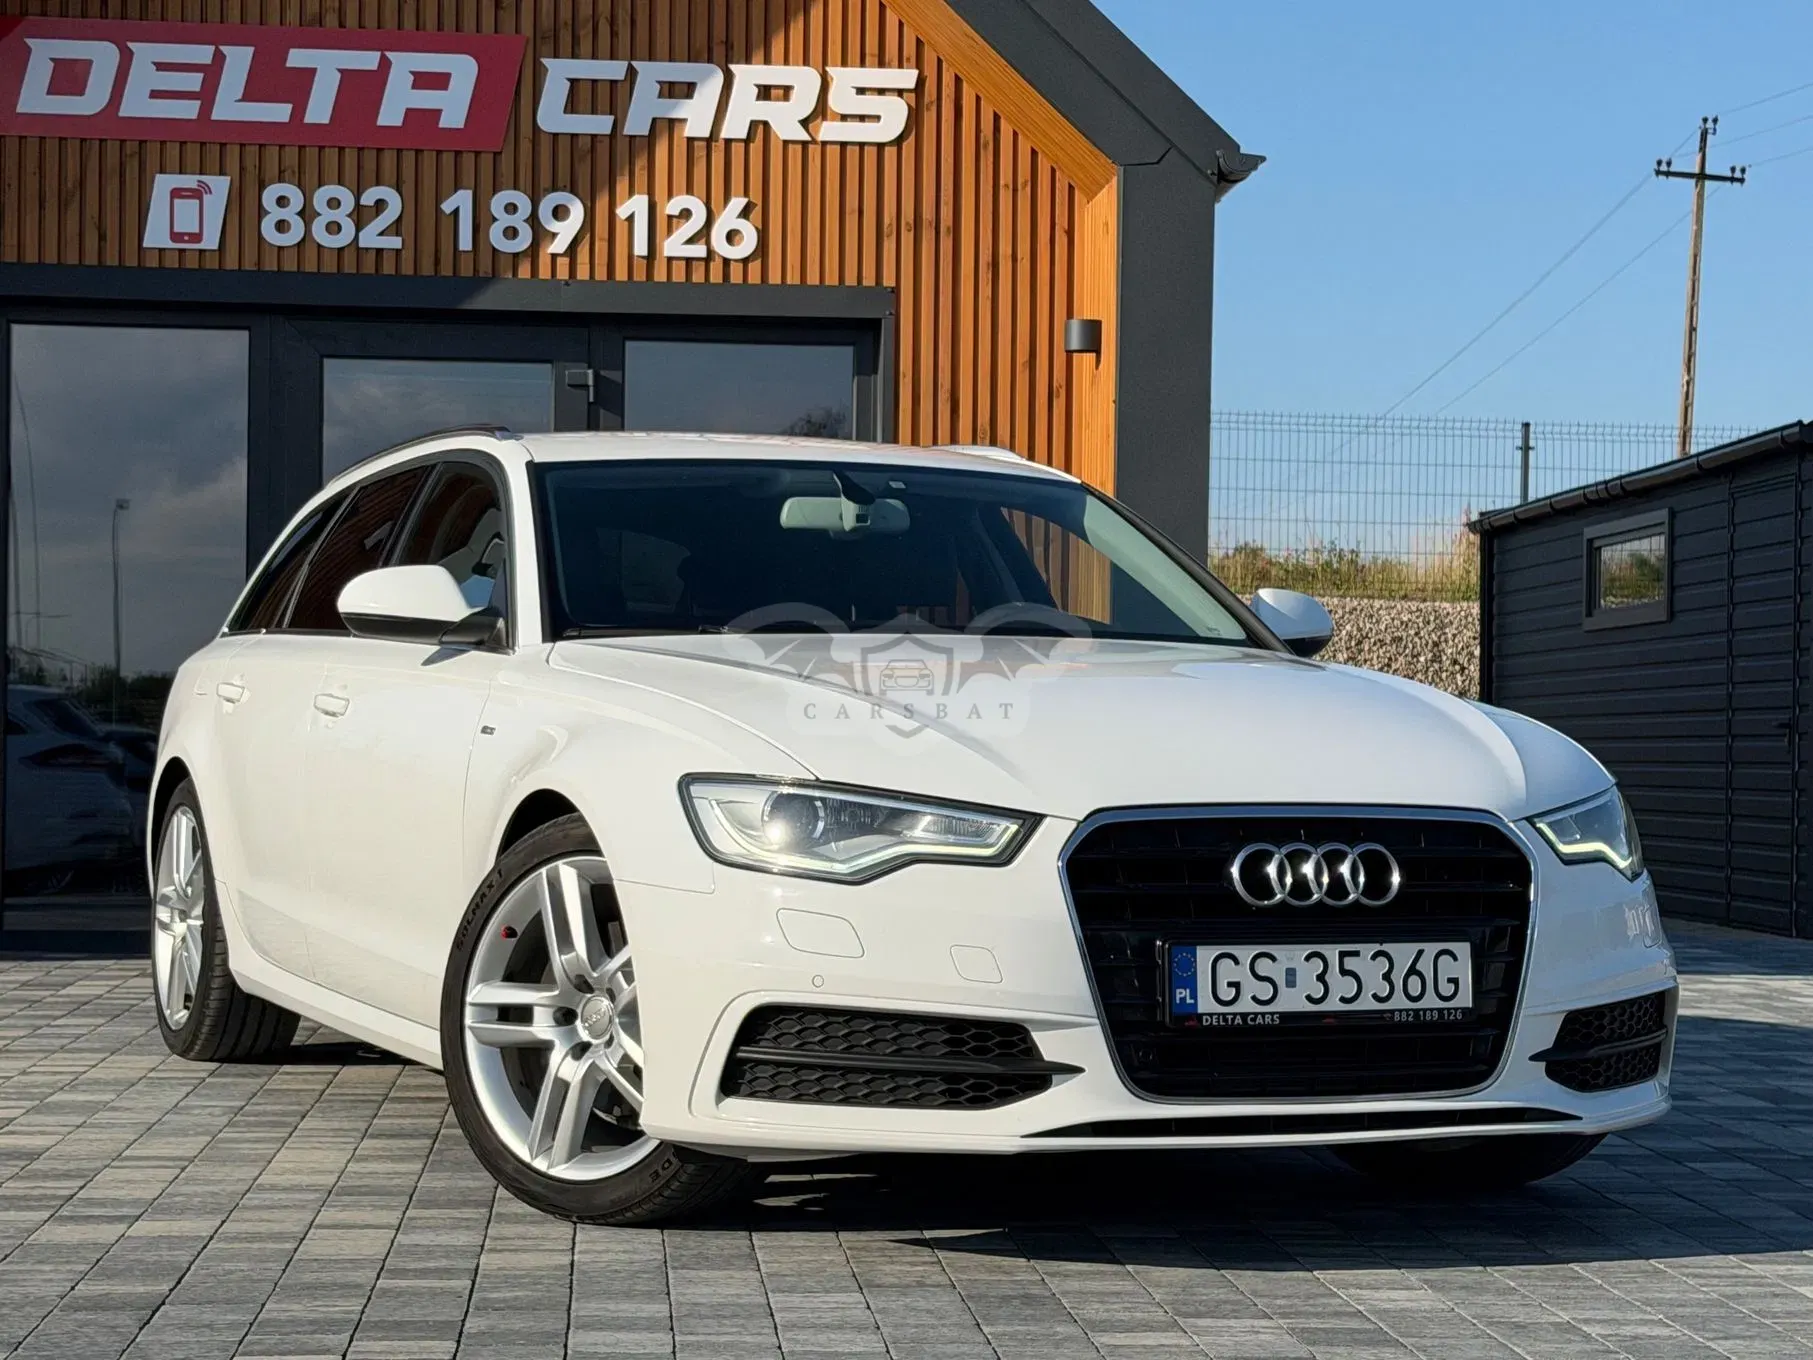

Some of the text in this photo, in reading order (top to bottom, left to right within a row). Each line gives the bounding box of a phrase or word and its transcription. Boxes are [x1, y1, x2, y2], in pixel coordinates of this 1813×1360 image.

[16, 37, 919, 143] DELTA CARS
[260, 183, 759, 260] 882 189 126
[1175, 988, 1195, 1004] PL
[1209, 948, 1460, 1007] GS 3536G
[1202, 1013, 1281, 1026] DELTA CARS
[1393, 1008, 1463, 1021] 882 189 126
